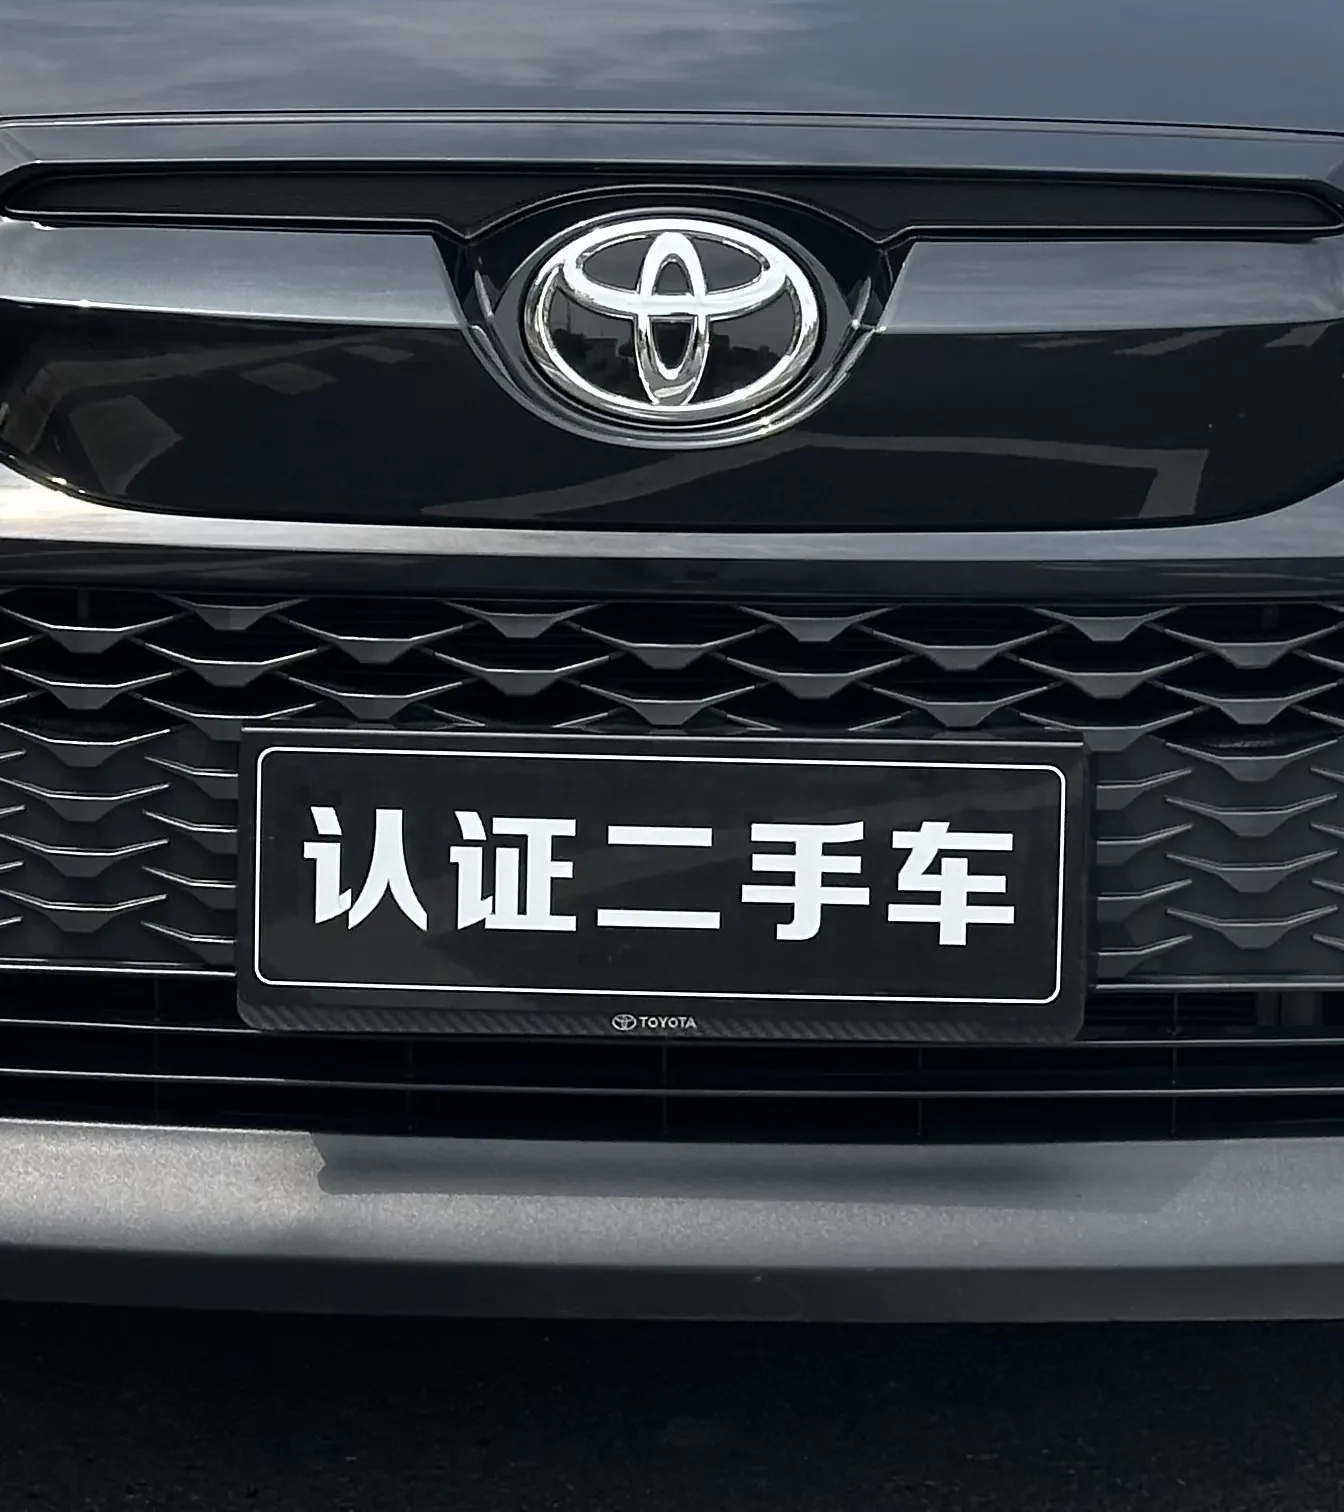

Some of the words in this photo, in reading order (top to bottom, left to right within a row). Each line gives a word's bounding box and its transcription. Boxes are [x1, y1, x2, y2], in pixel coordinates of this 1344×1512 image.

[303, 806, 1016, 946] 认证二手车
[638, 1016, 697, 1029] TOYOTA
